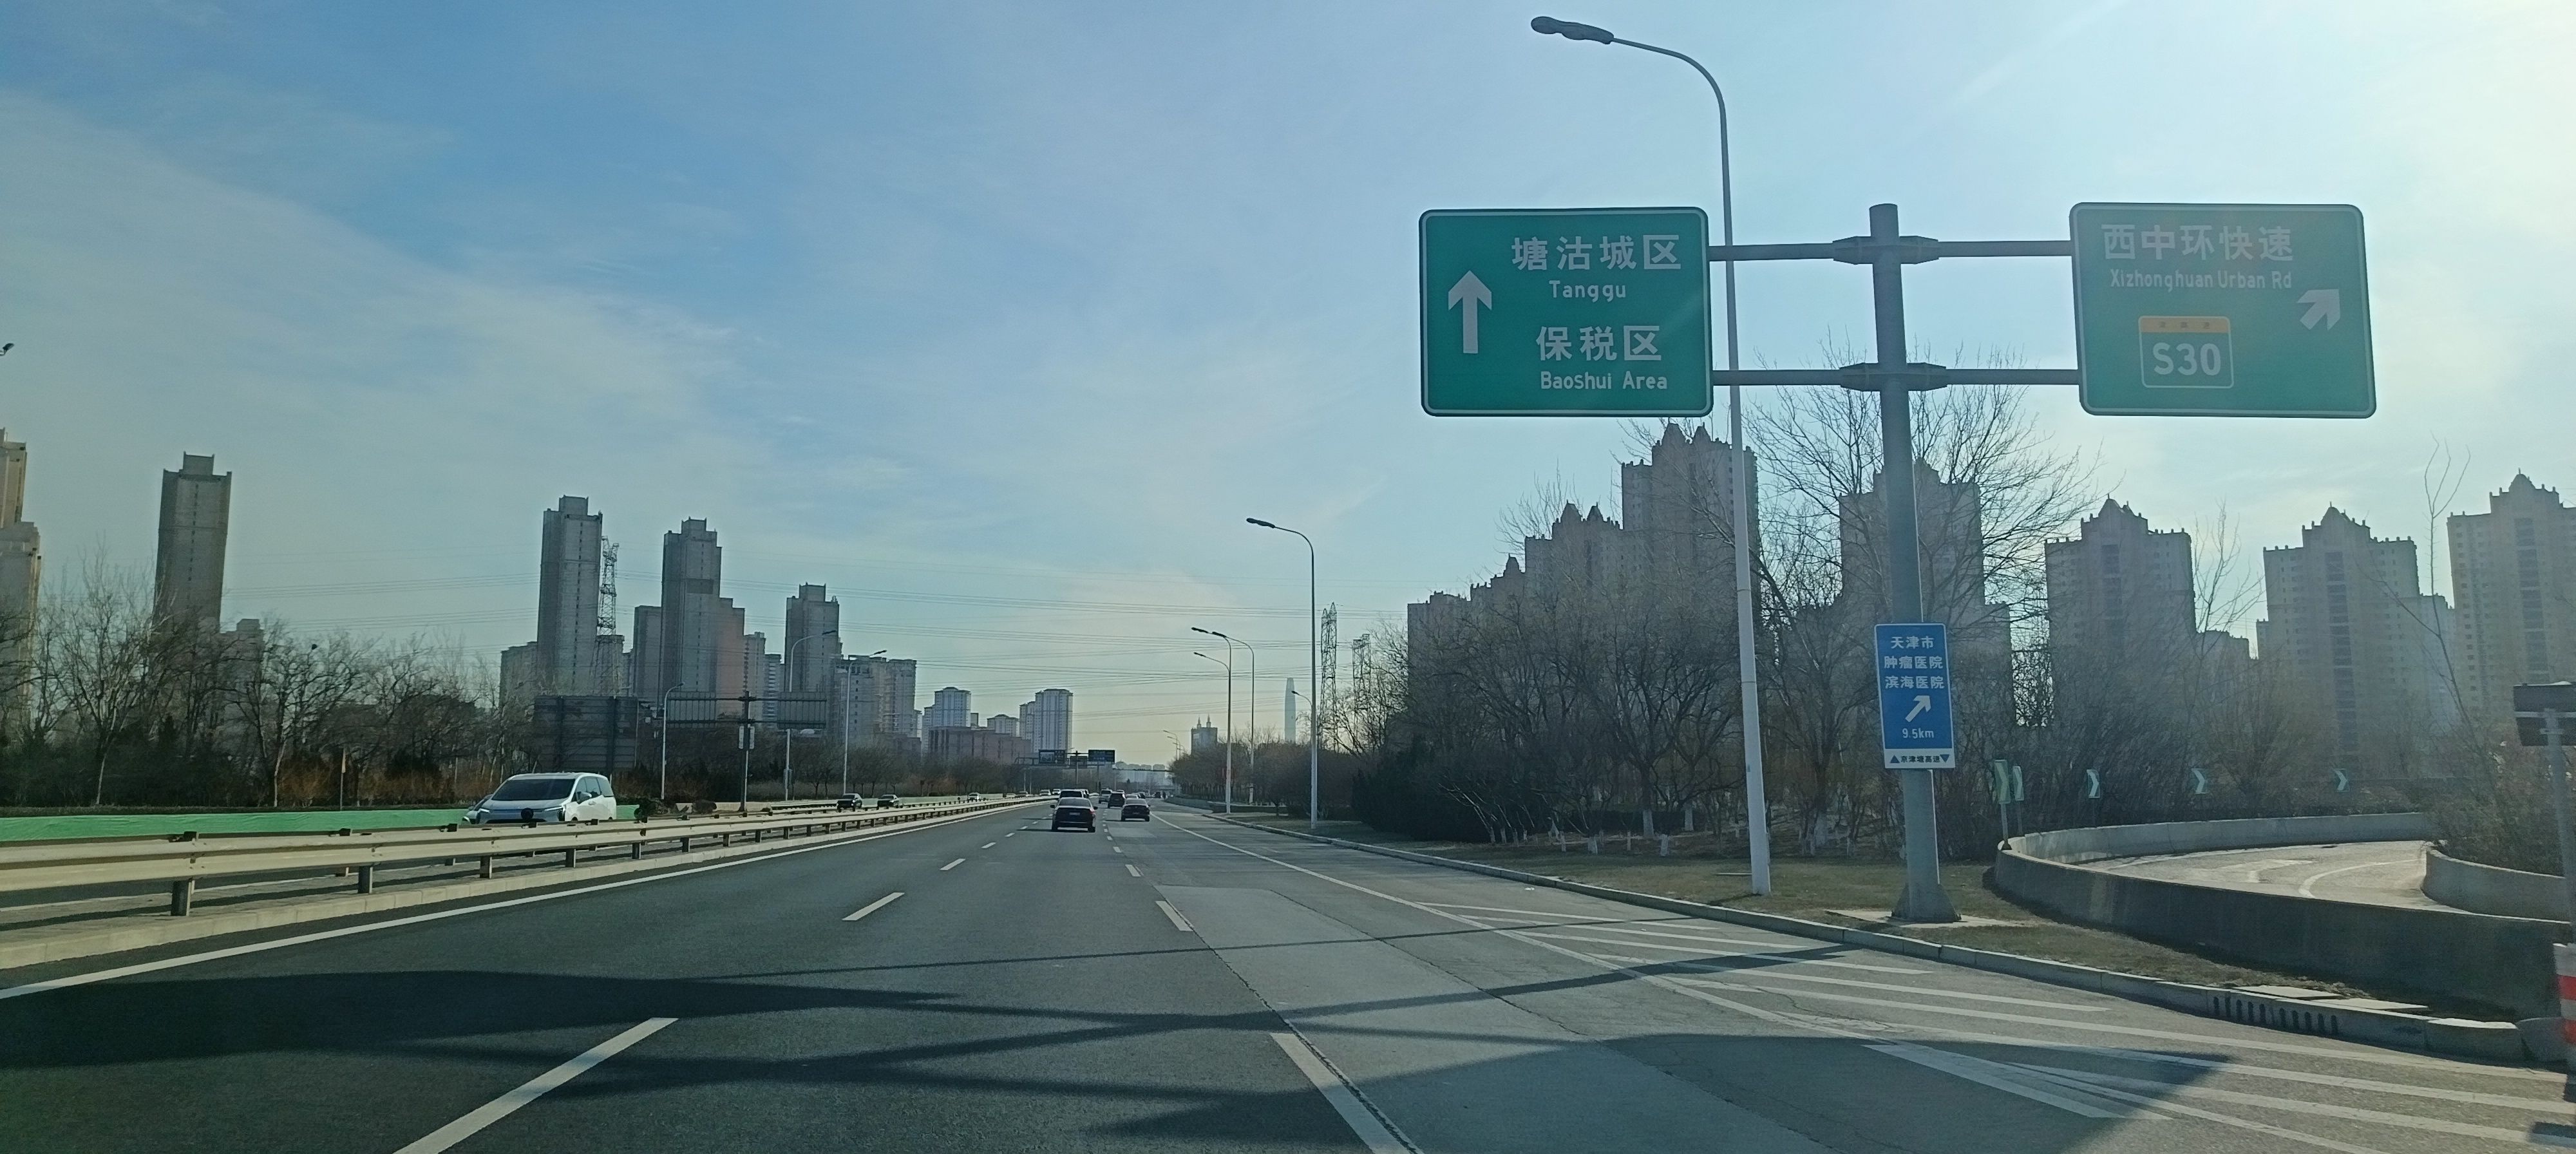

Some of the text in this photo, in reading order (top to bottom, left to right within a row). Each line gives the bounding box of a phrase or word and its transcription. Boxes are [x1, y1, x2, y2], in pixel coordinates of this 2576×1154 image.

[1511, 234, 1681, 270] 塘沽城区
[2101, 224, 2293, 261] 西中环快速
[1549, 280, 1626, 302] Tanggu
[2110, 269, 2292, 292] Xizhonghuan Urban Rd
[1536, 325, 1662, 361] 保税区
[2152, 342, 2221, 376] S30
[1622, 370, 1667, 390] Area
[1890, 636, 1934, 649] 天津市
[1884, 656, 1944, 669] 肿瘤医院
[1884, 676, 1945, 689] 滨海医院
[1902, 728, 1935, 739] 9.5km
